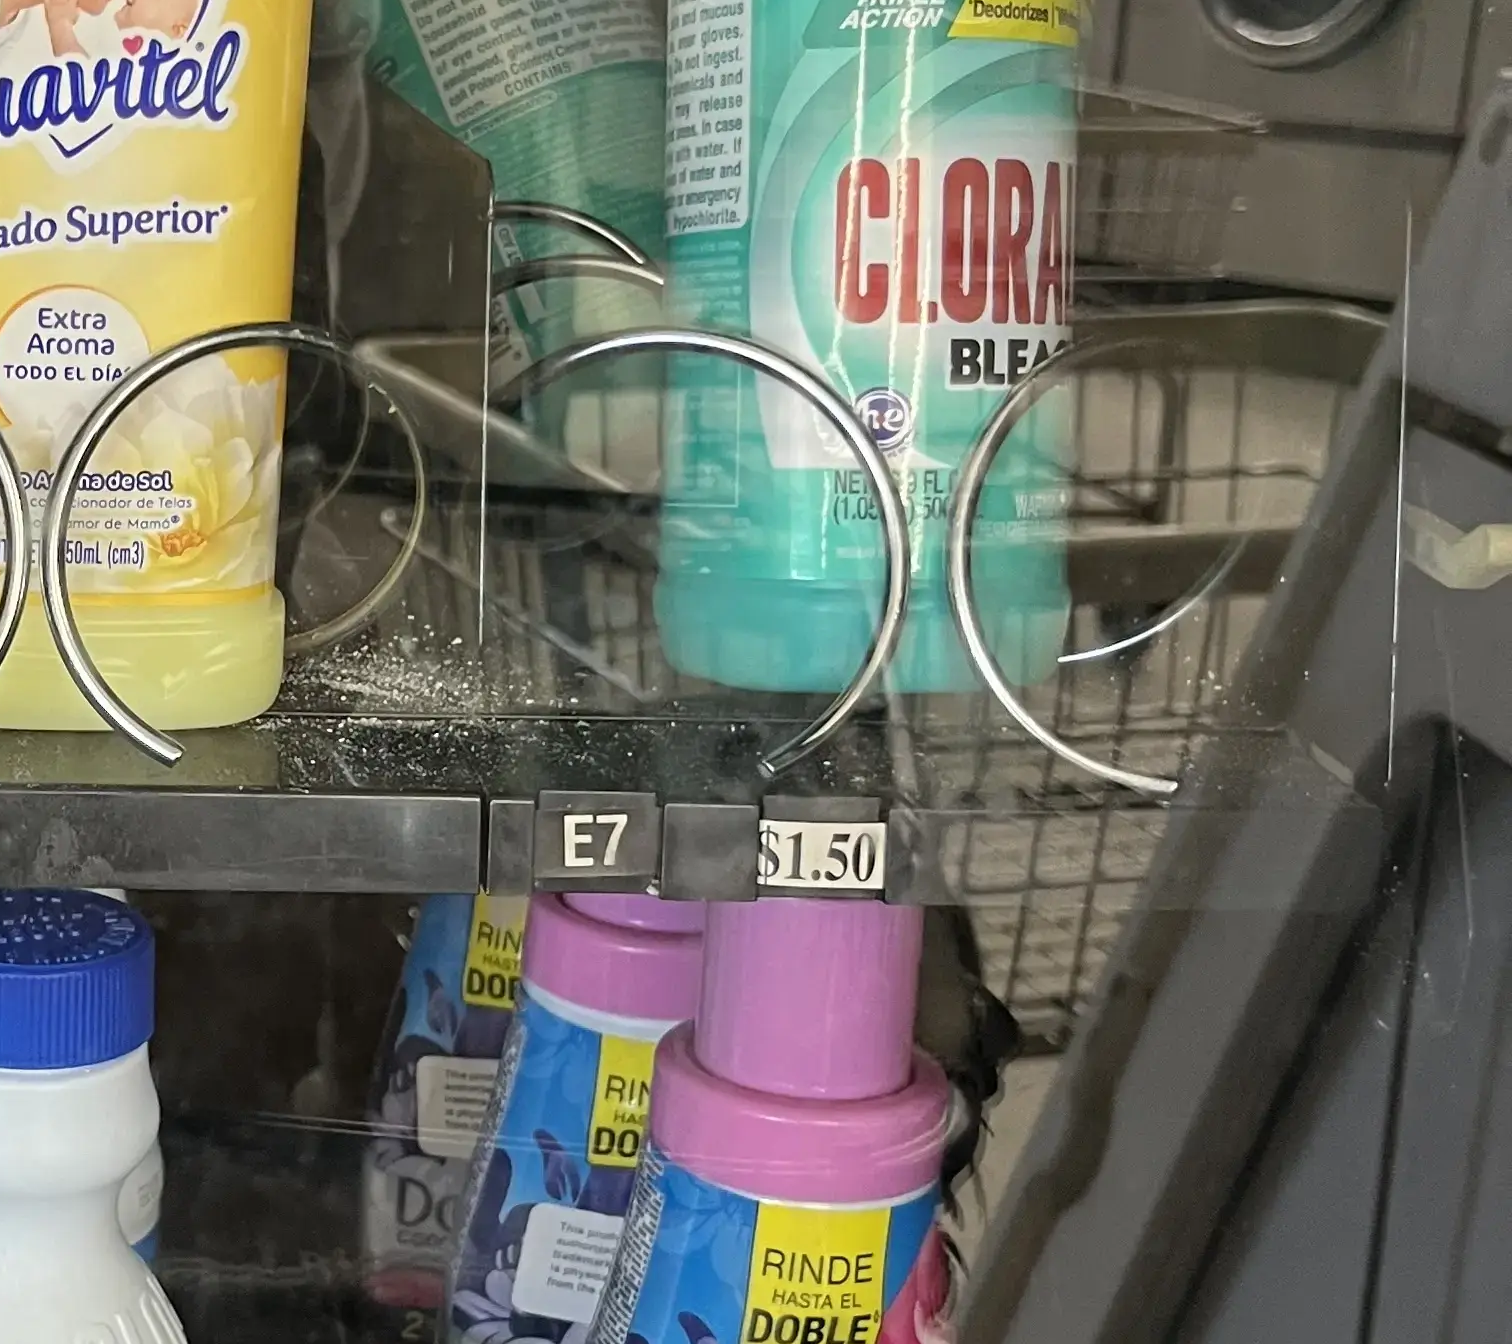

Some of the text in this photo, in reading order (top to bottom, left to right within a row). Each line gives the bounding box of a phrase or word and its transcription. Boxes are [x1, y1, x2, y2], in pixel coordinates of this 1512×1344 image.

[700, 2, 744, 22] mucous
[839, 8, 944, 30] ACTION
[700, 25, 744, 49] gloves.
[703, 45, 743, 69] ingest.
[720, 68, 743, 87] and
[699, 94, 743, 113] release
[715, 117, 743, 133] case
[719, 160, 742, 178] and
[835, 157, 1074, 324] CLORA
[37, 307, 107, 330] Extra
[26, 332, 116, 356] Aroma
[3, 363, 132, 383] TODO EL DÍA
[949, 338, 1068, 386] BLEA
[107, 470, 173, 491] de Sol
[136, 496, 193, 509] de Telas
[104, 517, 123, 530] de
[65, 540, 102, 565] 50mL
[107, 540, 145, 569] (cm3)
[563, 814, 629, 868] E7
[756, 824, 877, 885] $1.50
[477, 921, 524, 955] RIN
[761, 1248, 875, 1286] RINDE
[771, 1288, 862, 1310] HASTA EL
